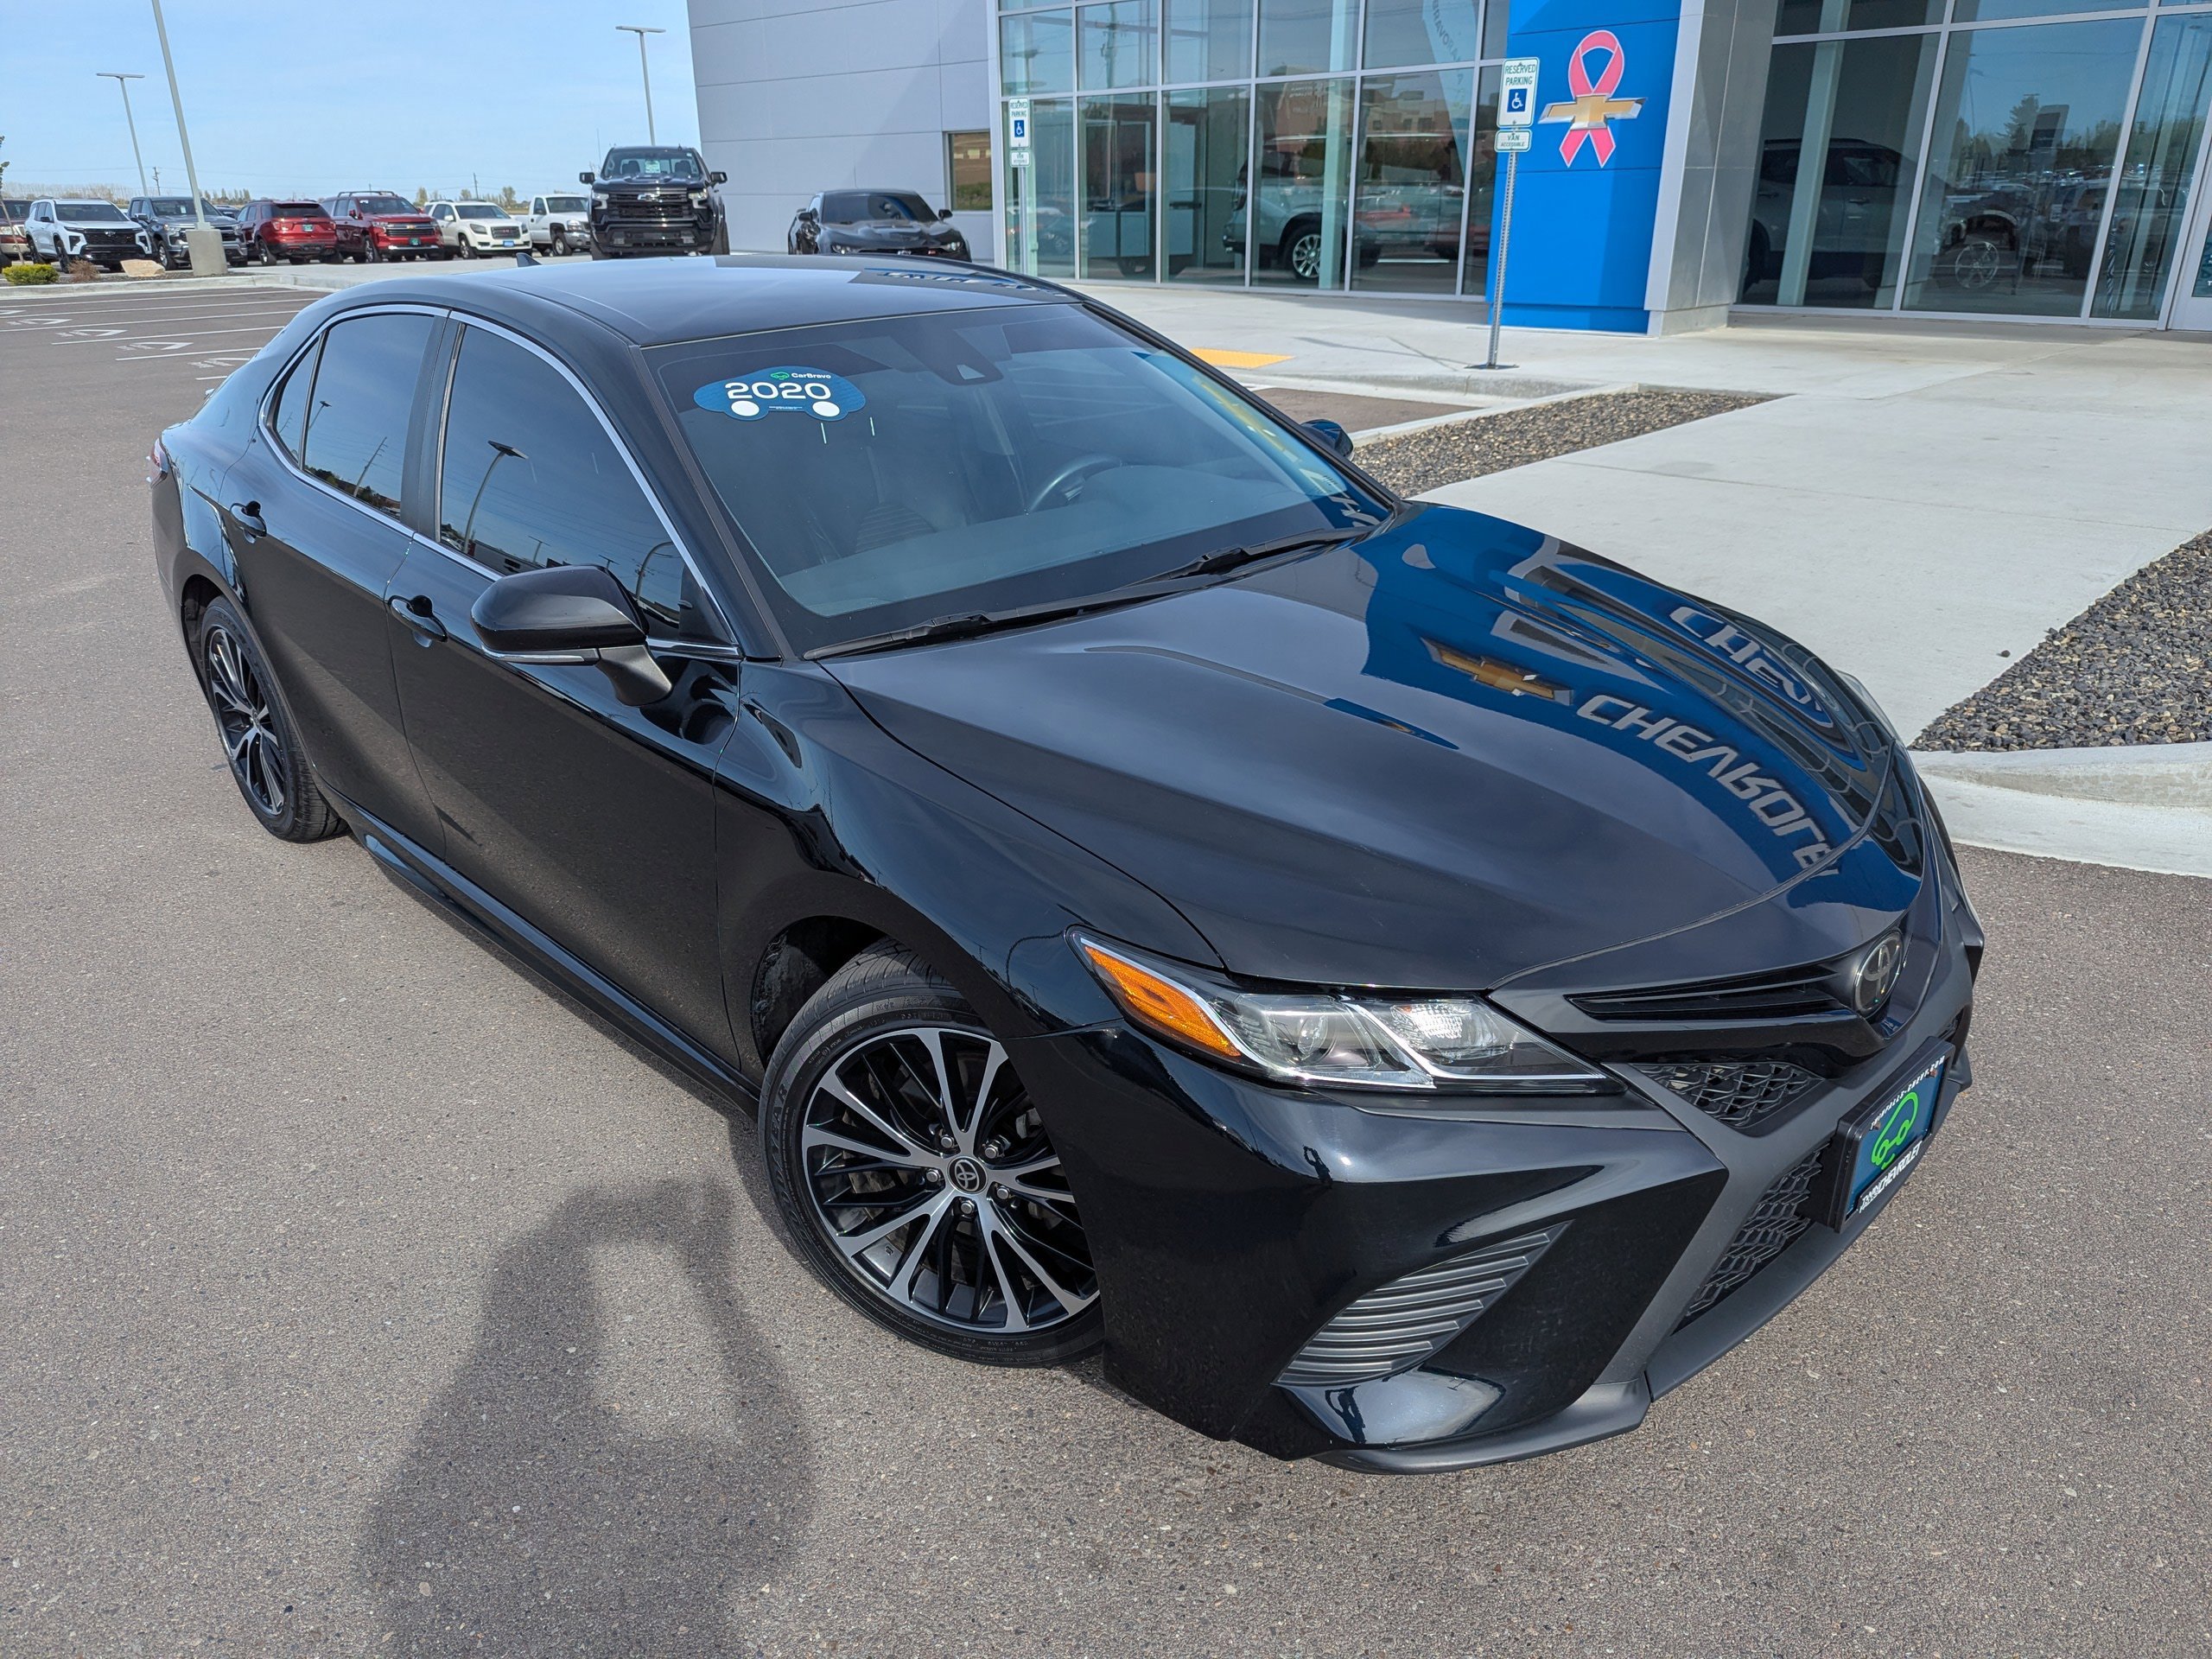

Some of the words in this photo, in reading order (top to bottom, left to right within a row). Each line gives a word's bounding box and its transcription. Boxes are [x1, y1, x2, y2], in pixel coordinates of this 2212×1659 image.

[1505, 64, 1536, 74] RESERVED
[1505, 76, 1533, 86] PARKING
[724, 381, 832, 400] 2020
